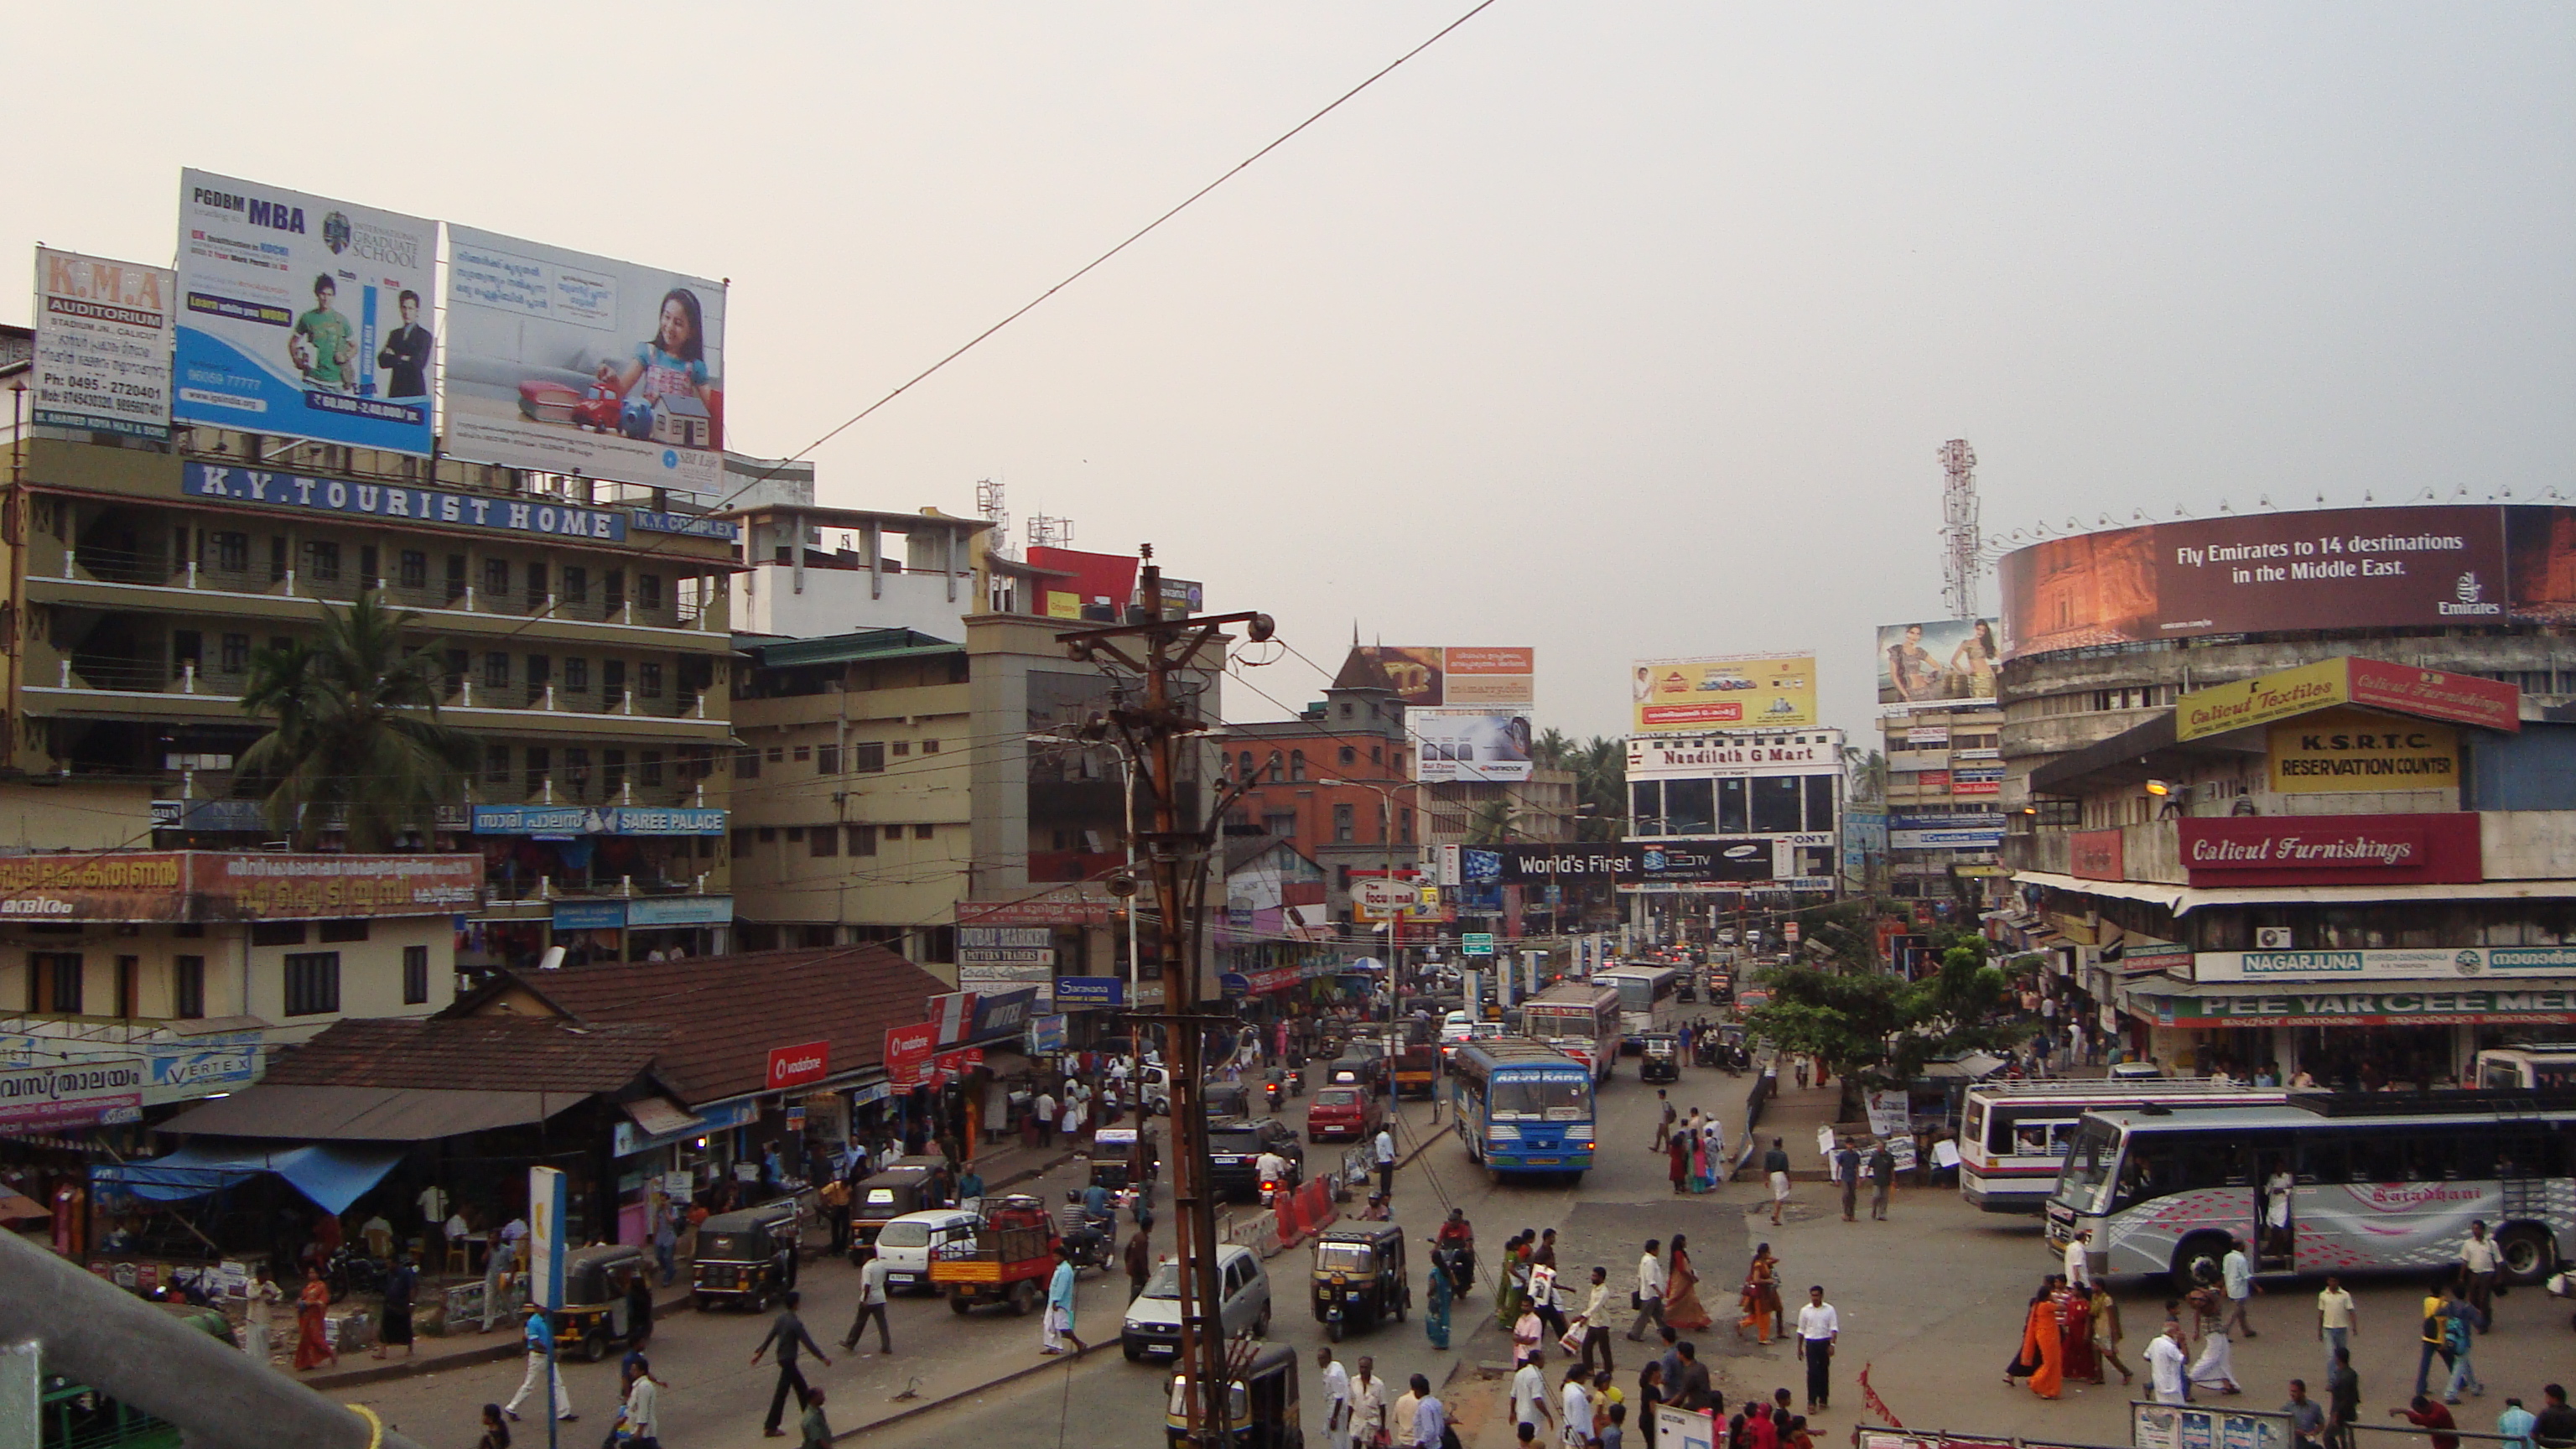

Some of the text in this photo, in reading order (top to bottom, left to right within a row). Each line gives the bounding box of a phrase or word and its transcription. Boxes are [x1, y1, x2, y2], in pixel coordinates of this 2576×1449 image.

[194, 187, 305, 235] PGDBM MBA
[353, 231, 418, 255] GRADUATE
[353, 243, 418, 269] SCHOOL
[50, 299, 160, 328] AUDITORIUM
[50, 318, 95, 331] STADIUM
[117, 327, 158, 340] CALICUT
[44, 372, 64, 387] Ph:
[68, 376, 99, 391] 0495
[110, 382, 161, 399] 2720401
[509, 503, 612, 539] HOME
[667, 515, 734, 538] COMPLEX
[2177, 532, 2464, 568] Fly Emirates to 14 destinations
[2232, 558, 2407, 584] in the Middle East.
[2438, 599, 2501, 616] Emirates
[2357, 673, 2411, 693] Calicut
[2190, 697, 2252, 725] Calicut
[2257, 681, 2333, 709] Textiles
[1664, 747, 1814, 765] Nandilath G Mart
[2282, 756, 2451, 776] RESERVATION COUNTER
[621, 813, 724, 831] SAREE PALACE
[1696, 854, 1711, 865] TV
[2192, 836, 2412, 865] Calicut Furnishings
[1519, 854, 1633, 874] World's First
[1365, 887, 1415, 904] focu mall
[1366, 883, 1379, 891] The
[960, 927, 1052, 947] DUBAI MARKET
[2246, 953, 2360, 972] NAGARJUNA
[1059, 980, 1109, 994] Saravana
[2200, 996, 2289, 1015] PEE
[2298, 995, 2376, 1014] YAR
[2381, 993, 2488, 1013] CEE
[901, 1035, 929, 1052] vodafone
[170, 1058, 250, 1084] VERTEX
[787, 1056, 822, 1074] vodafone
